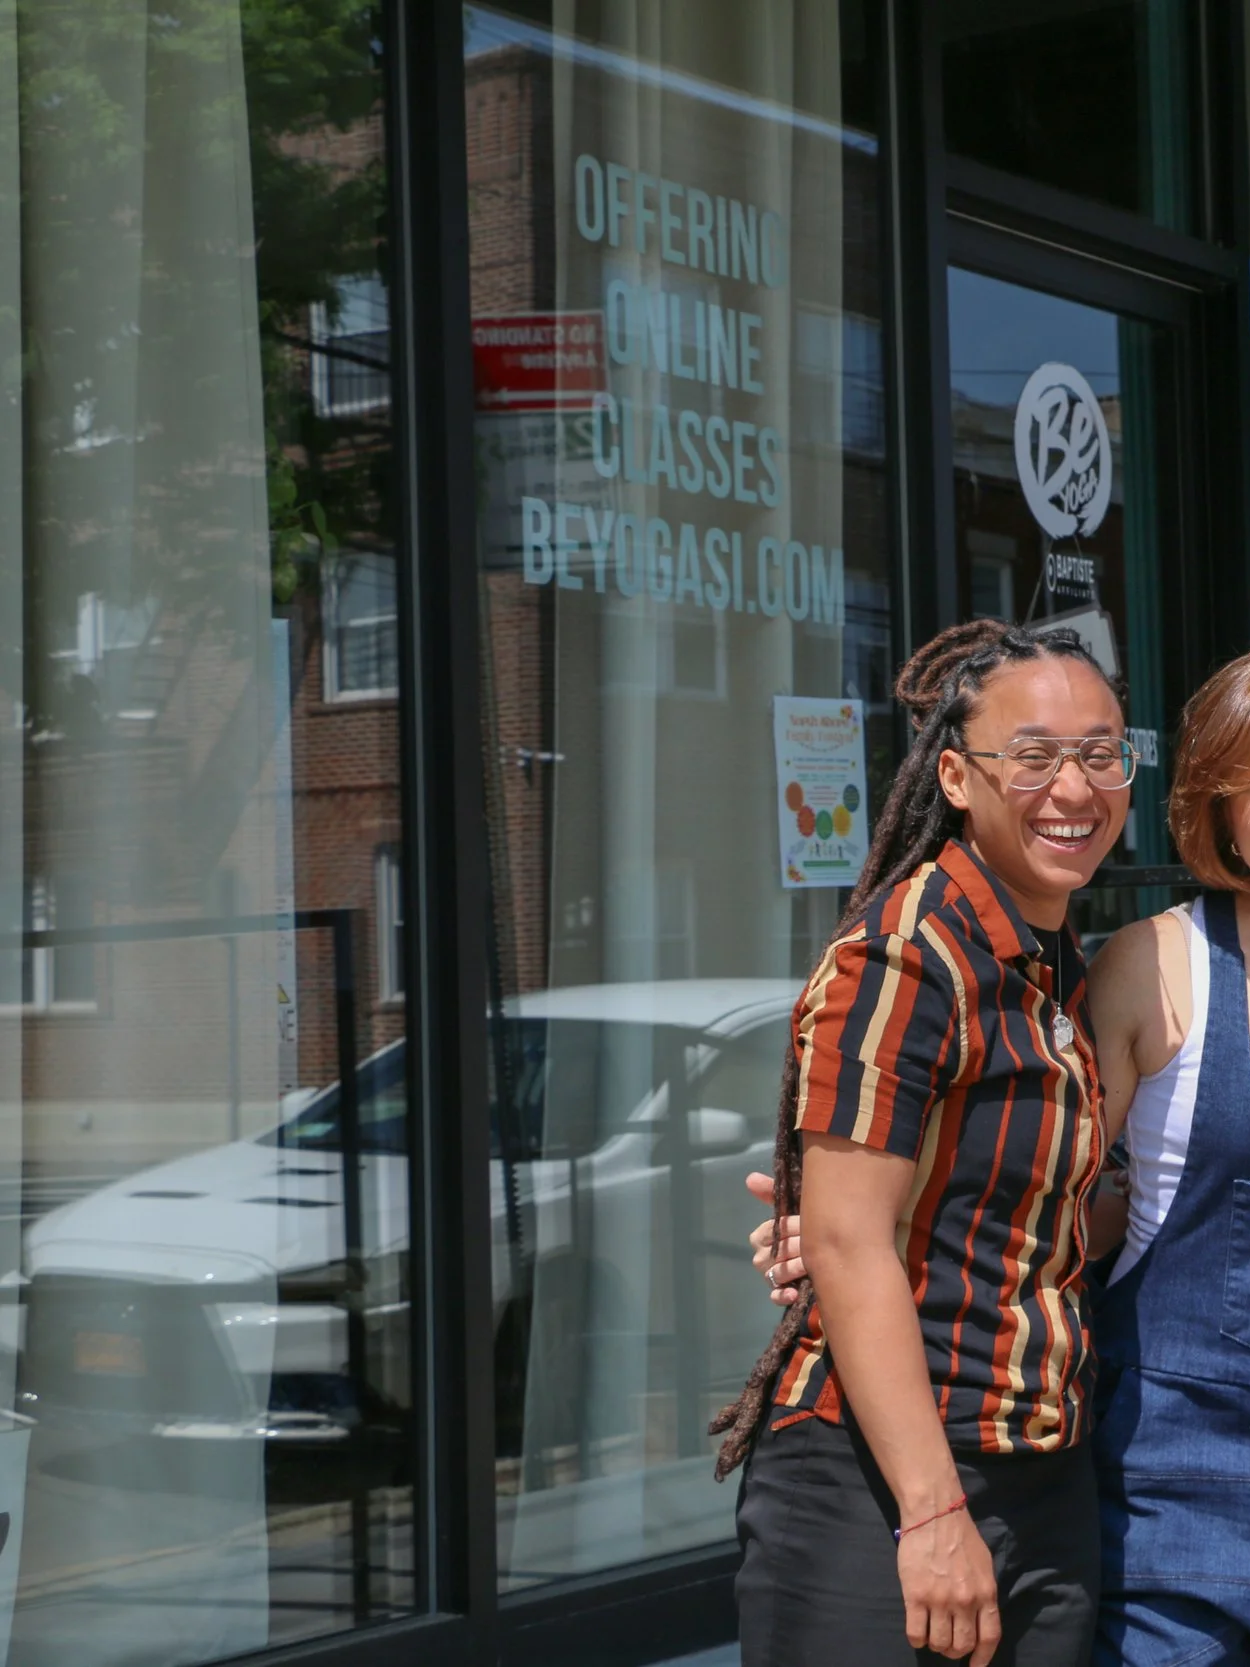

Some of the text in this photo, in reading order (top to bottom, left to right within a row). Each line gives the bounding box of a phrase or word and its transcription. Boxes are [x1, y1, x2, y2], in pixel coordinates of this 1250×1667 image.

[574, 153, 788, 290] OFFERING
[605, 278, 764, 396] ONLINE
[590, 390, 785, 509] CLASSES
[1059, 468, 1100, 516] YOGA
[521, 495, 845, 626] BEYOGASI.COM
[1056, 554, 1095, 584] BAPTISTE
